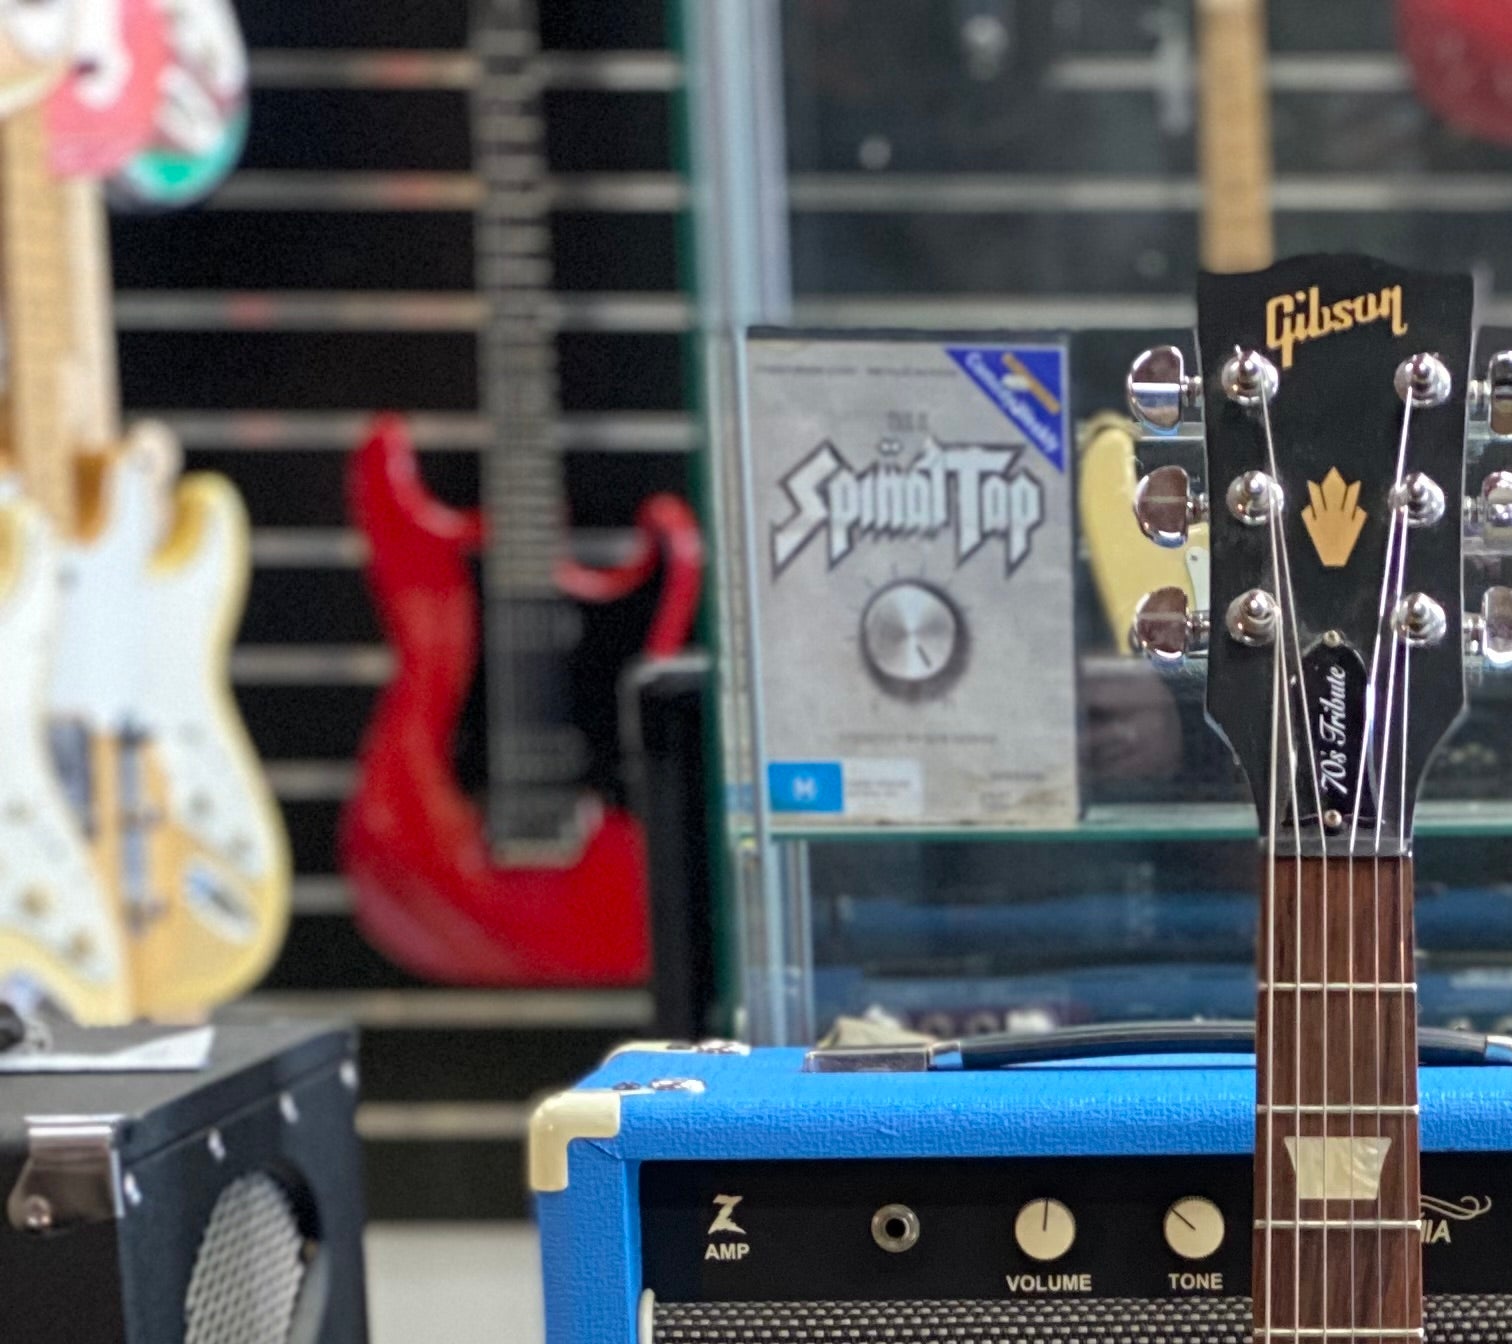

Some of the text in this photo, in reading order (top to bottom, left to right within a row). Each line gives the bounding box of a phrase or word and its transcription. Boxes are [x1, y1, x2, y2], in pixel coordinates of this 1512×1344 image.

[1265, 284, 1408, 369] Gibson
[934, 442, 1046, 579] Tap
[1318, 665, 1348, 795] 70's Tribute
[707, 1193, 747, 1235] Z
[704, 1242, 750, 1261] AMP
[1005, 1272, 1224, 1292] VOLUME TONE
